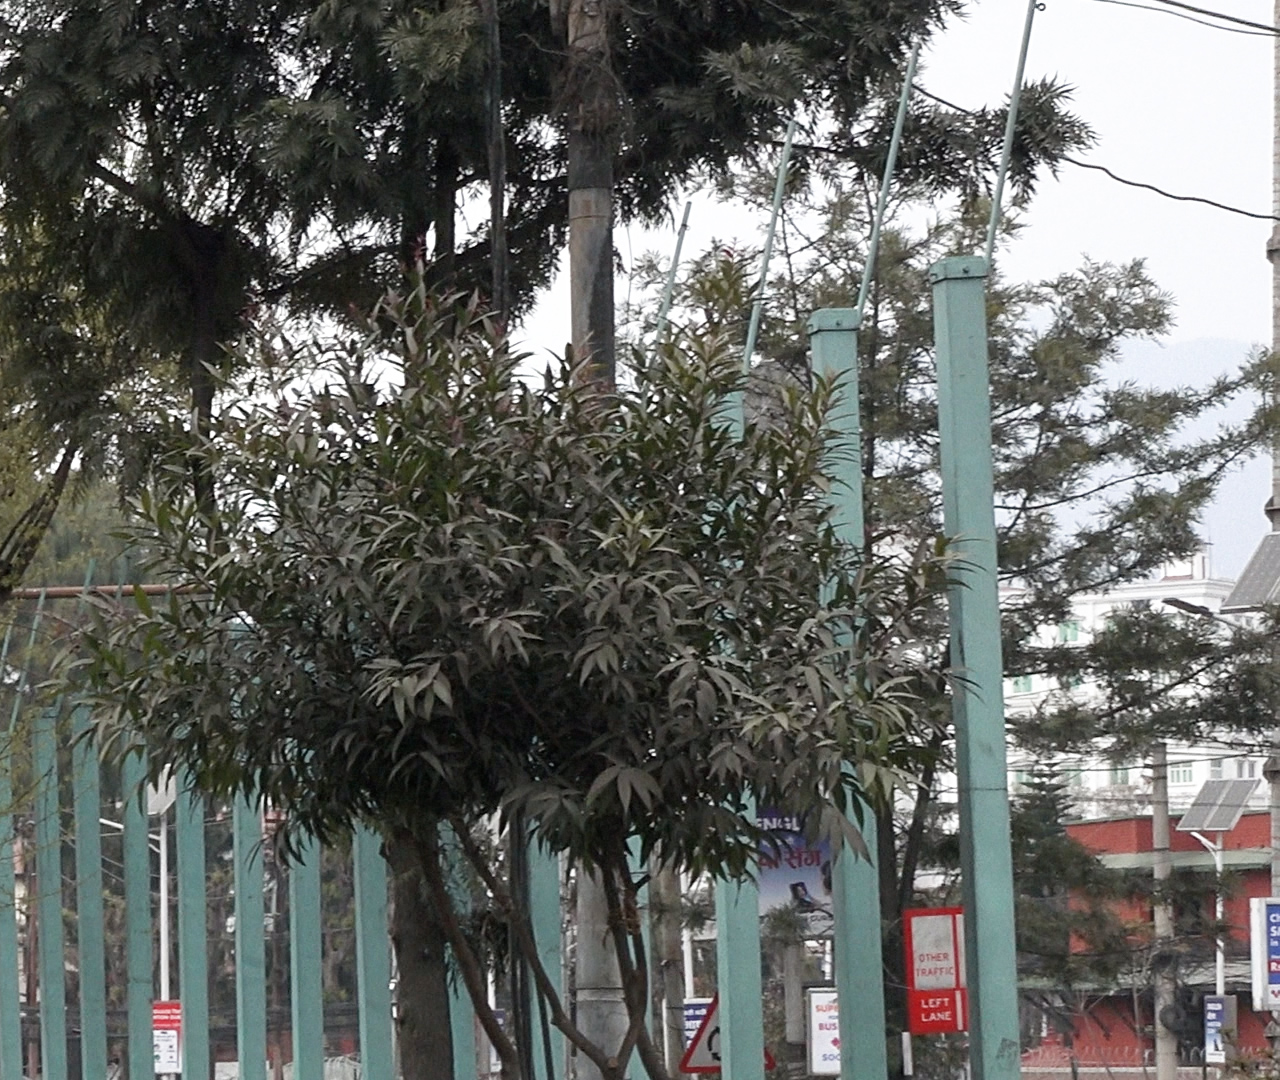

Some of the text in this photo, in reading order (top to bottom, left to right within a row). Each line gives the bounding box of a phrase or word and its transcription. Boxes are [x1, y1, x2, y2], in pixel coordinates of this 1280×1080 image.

[919, 953, 950, 962] OTHER
[916, 967, 955, 977] TRAFFIC
[921, 998, 950, 1008] LEFT
[921, 1011, 952, 1022] LANE
